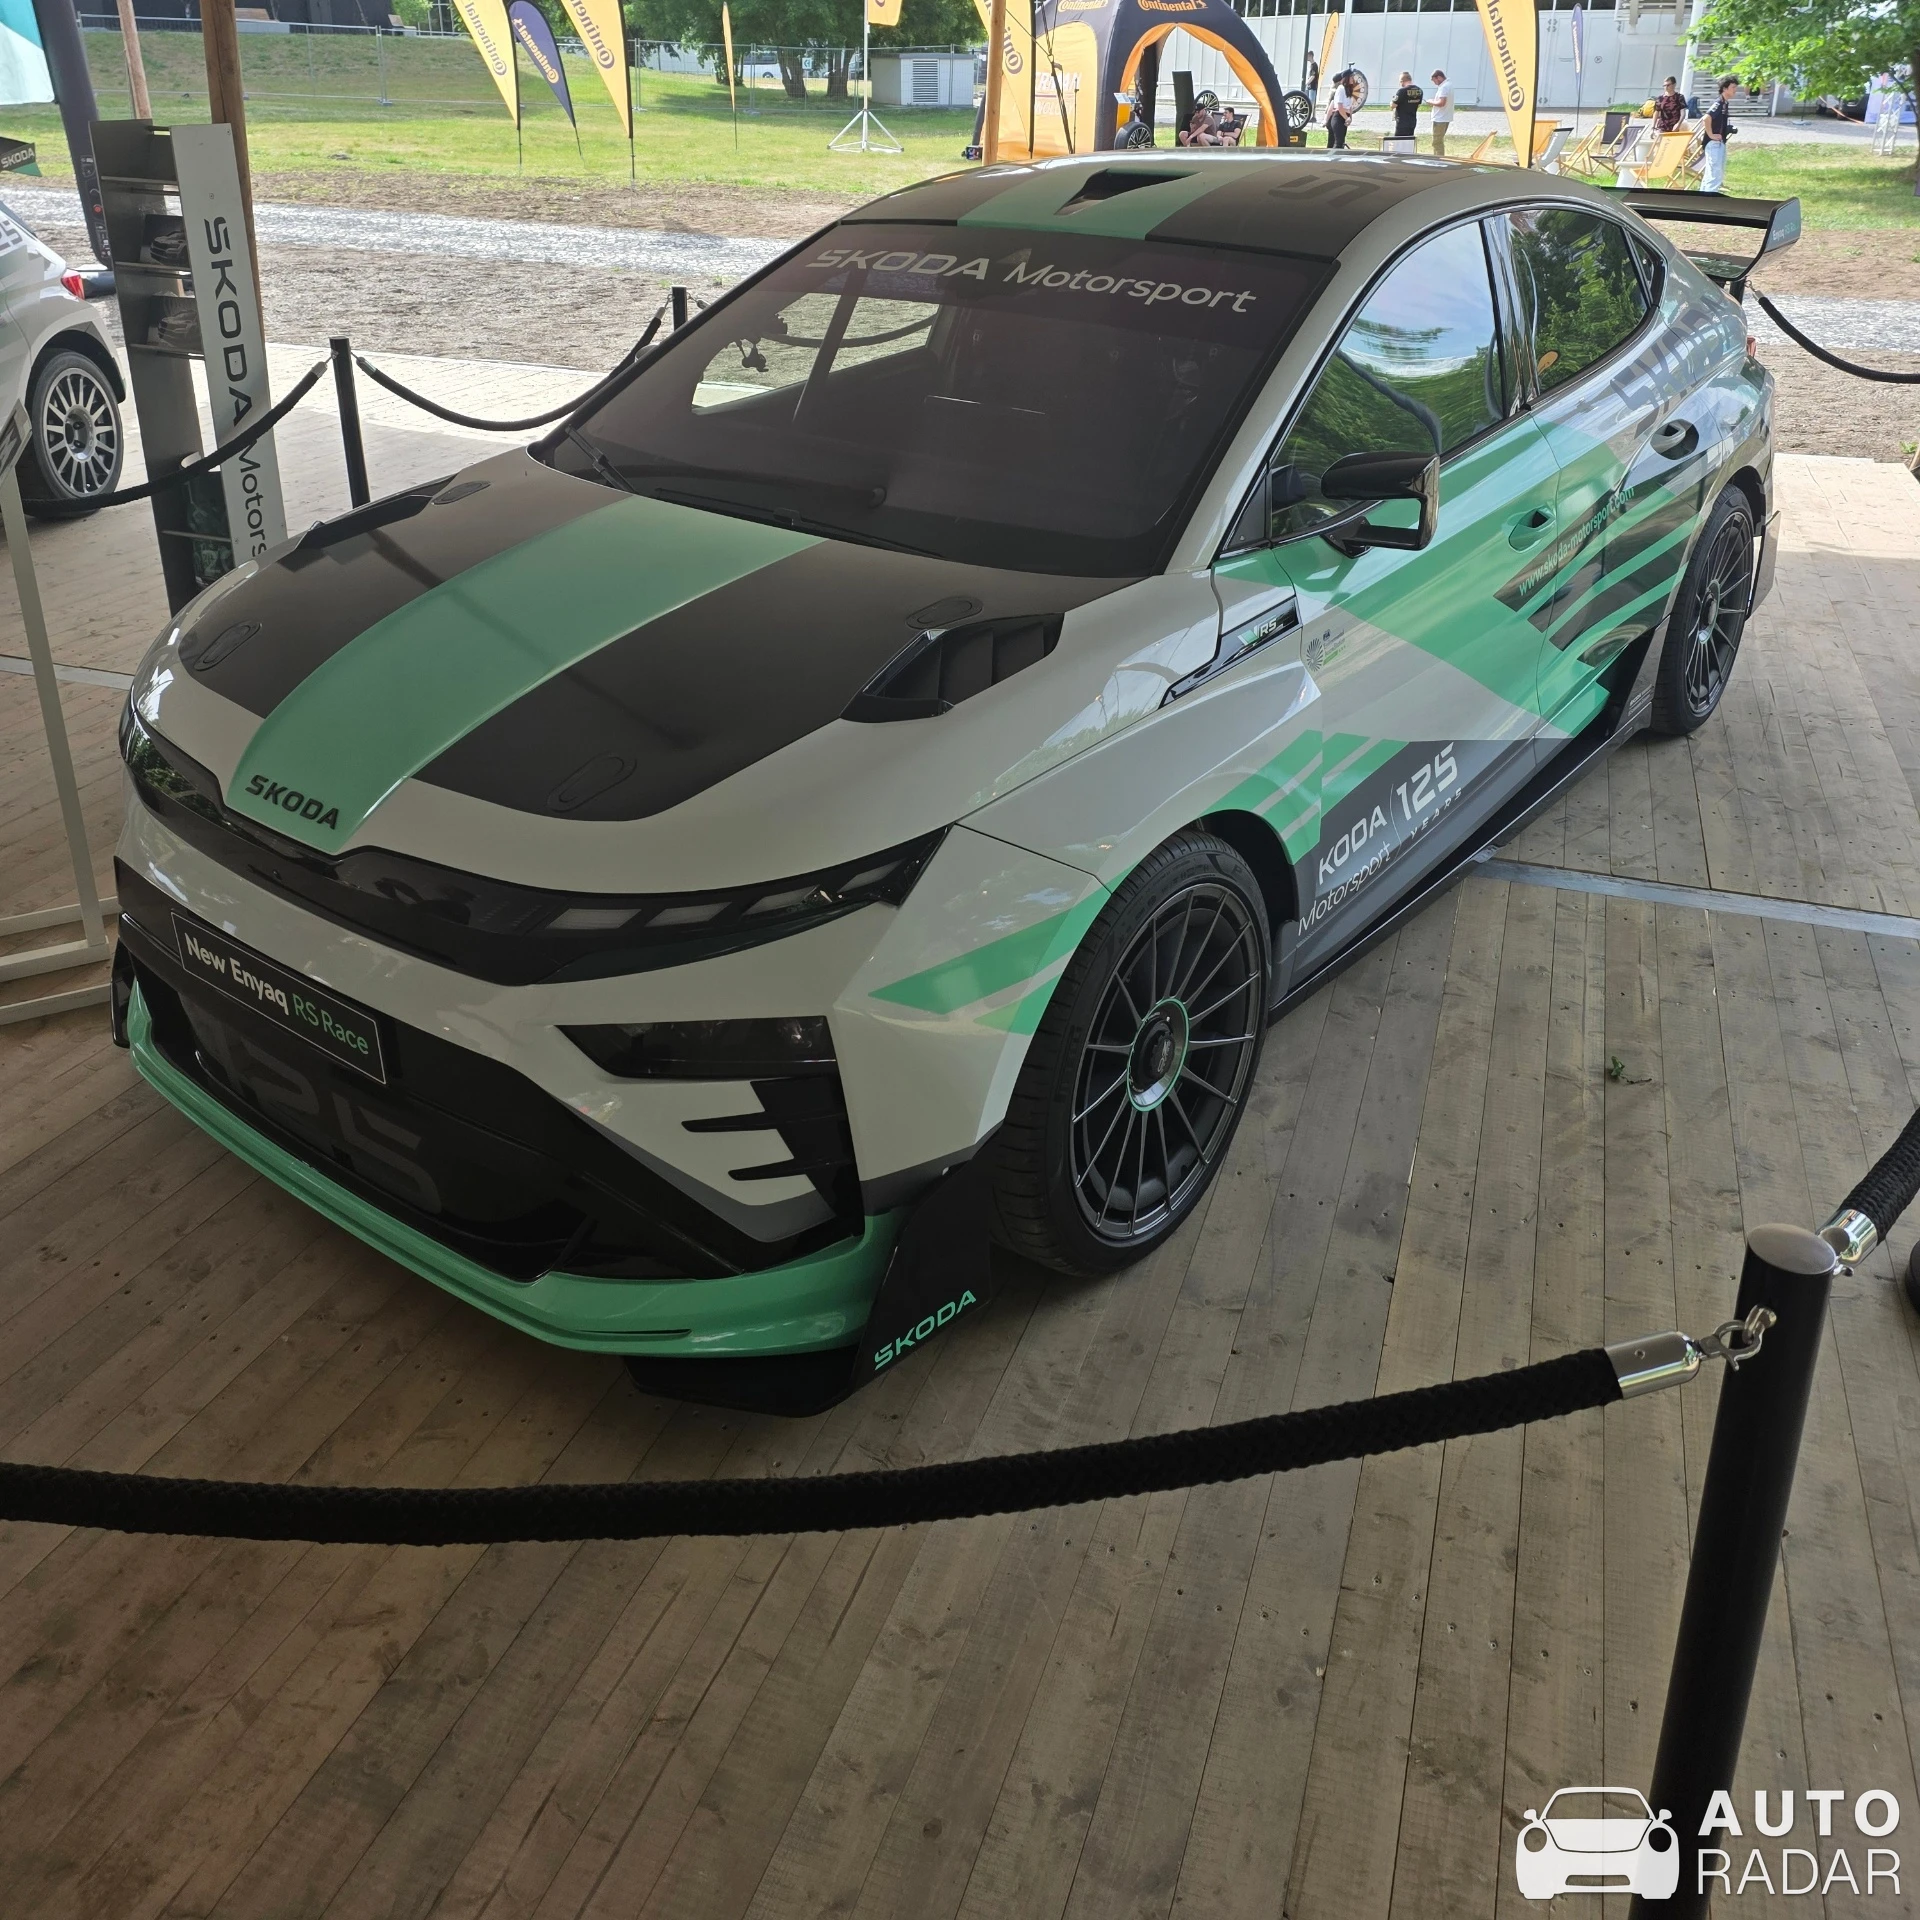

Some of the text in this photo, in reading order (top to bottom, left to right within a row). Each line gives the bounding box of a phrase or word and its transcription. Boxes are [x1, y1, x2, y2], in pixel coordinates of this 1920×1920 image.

[1, 147, 35, 169] SKODA
[805, 248, 1257, 314] SKODA Motorsport
[204, 217, 253, 427] SKODA
[1519, 487, 1634, 597] www.skoda-motorsport.com
[245, 774, 339, 830] SKODA
[1396, 741, 1458, 821] 125
[1298, 841, 1391, 937] Motorsport
[184, 933, 369, 1055] New Enyaq RS Race
[874, 1290, 977, 1370] SKODA
